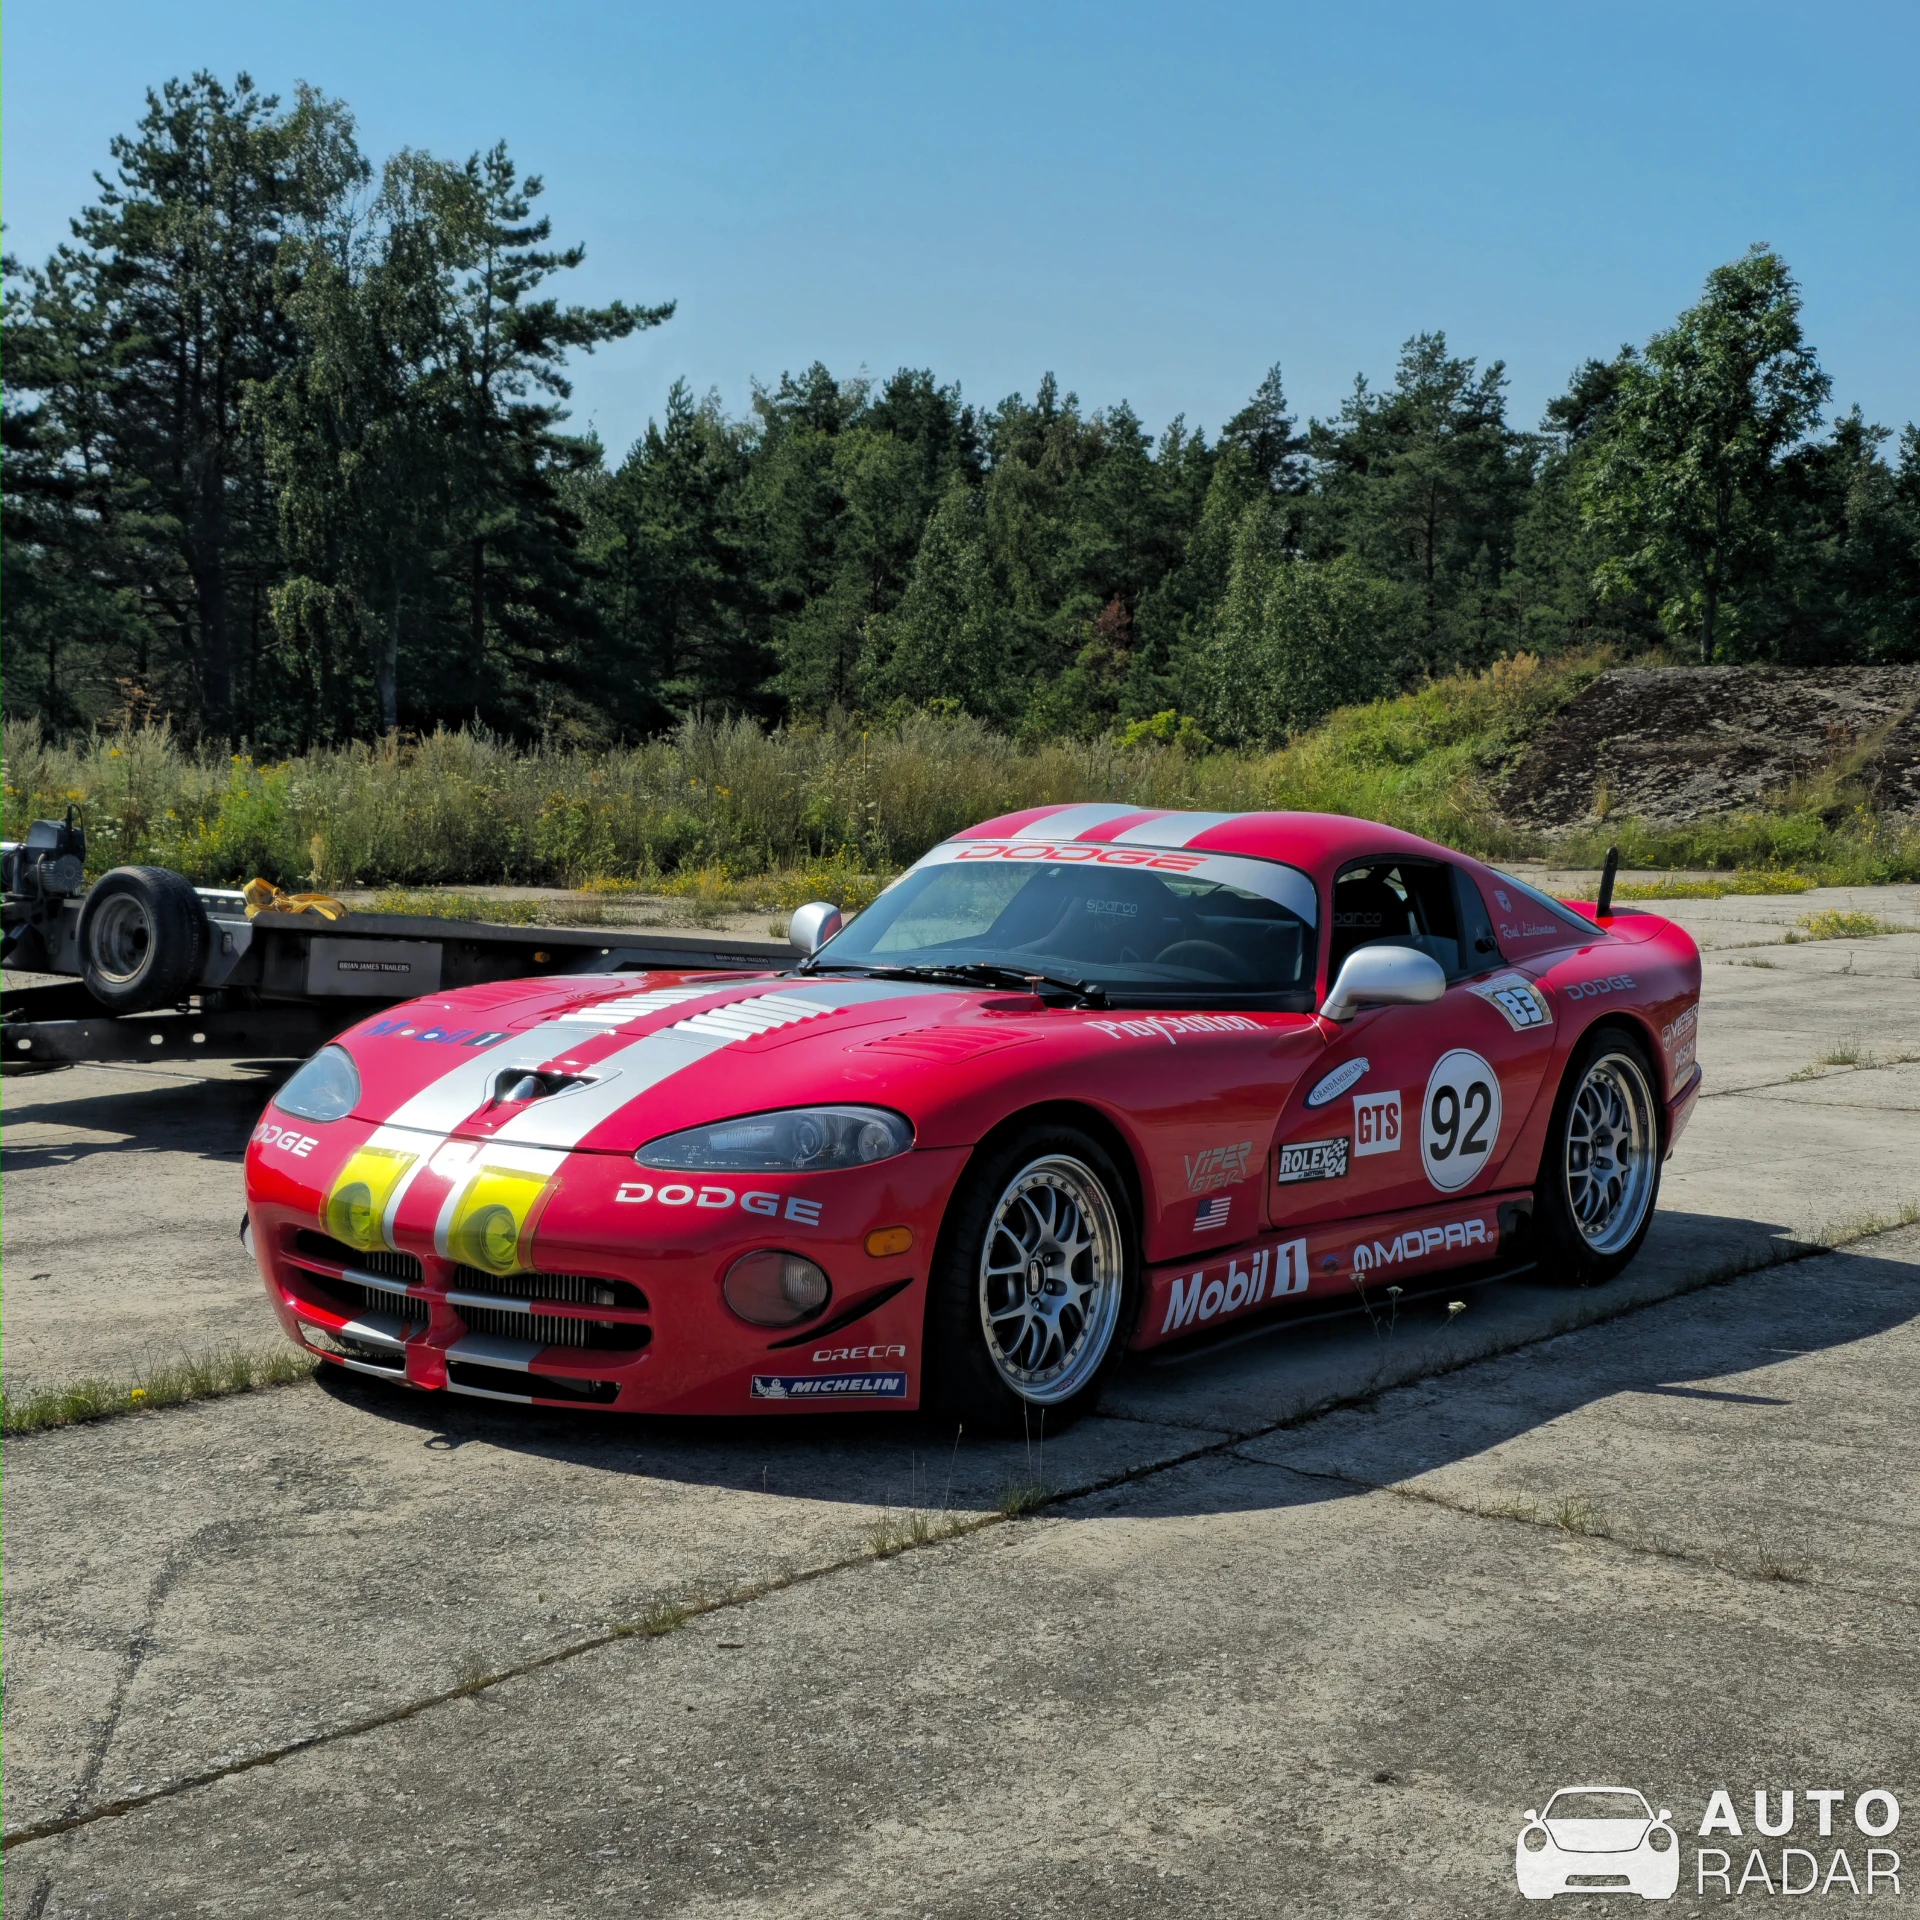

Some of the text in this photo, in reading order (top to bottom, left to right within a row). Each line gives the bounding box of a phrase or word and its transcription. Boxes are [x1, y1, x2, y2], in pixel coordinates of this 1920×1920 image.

[953, 845, 1209, 872] DODGE
[1086, 899, 1138, 914] sparco
[1563, 974, 1637, 1000] DODGE
[1494, 987, 1543, 1026] 83
[360, 1020, 476, 1045] Mobil
[1358, 1103, 1399, 1145] GTS
[1430, 1081, 1492, 1161] 92
[253, 1123, 320, 1158] ODGE
[1184, 1141, 1252, 1189] VIPER
[1279, 1147, 1347, 1178] ROLEX 24
[615, 1182, 823, 1226] DODGE
[1373, 1219, 1486, 1268] MOPAR
[1161, 1249, 1269, 1334] Mobil
[812, 1345, 906, 1362] ORECA
[790, 1378, 900, 1393] MICHELIN
